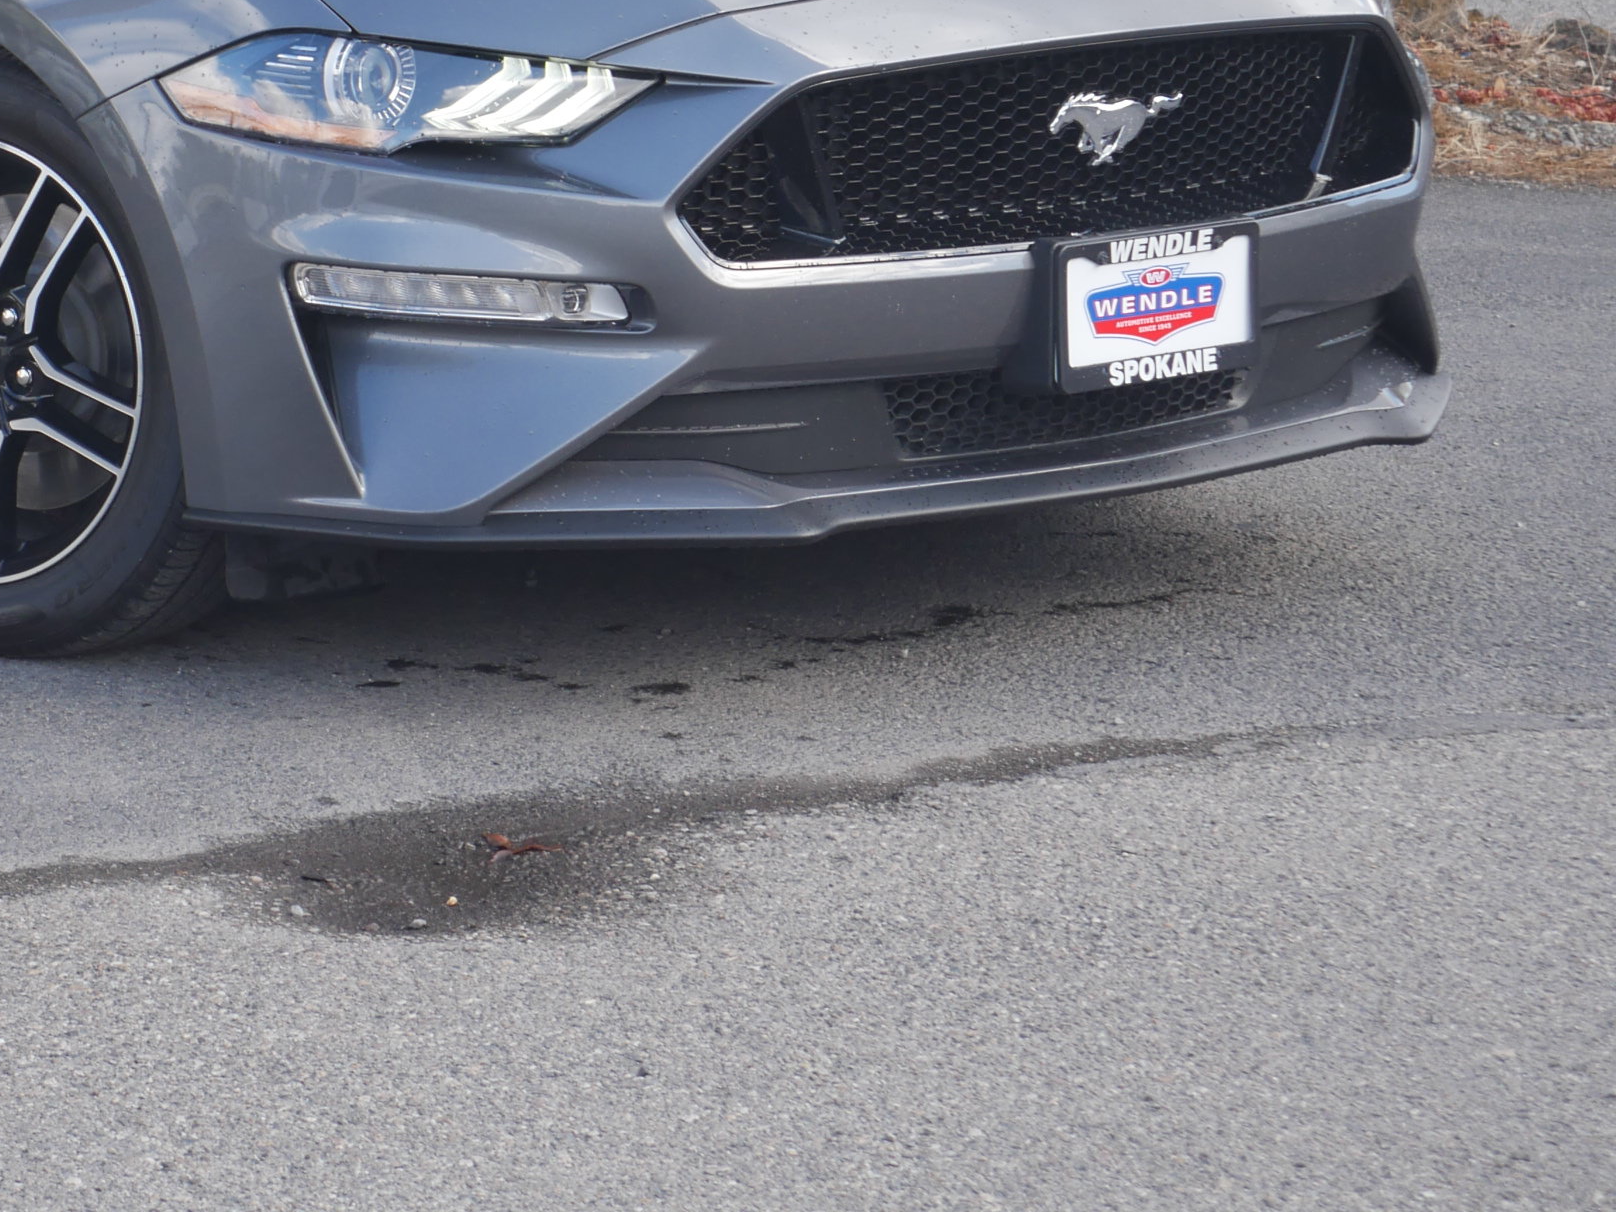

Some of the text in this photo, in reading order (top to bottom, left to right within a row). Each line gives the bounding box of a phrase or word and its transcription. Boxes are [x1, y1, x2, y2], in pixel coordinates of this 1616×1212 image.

[1110, 228, 1214, 263] WENDLE
[1146, 270, 1166, 284] W
[1094, 285, 1213, 318] WENDLE
[1116, 311, 1192, 328] AUTOMOTIVE EXCELLENCE
[1138, 324, 1156, 333] SINCE
[1109, 347, 1218, 387] SPOKANE
